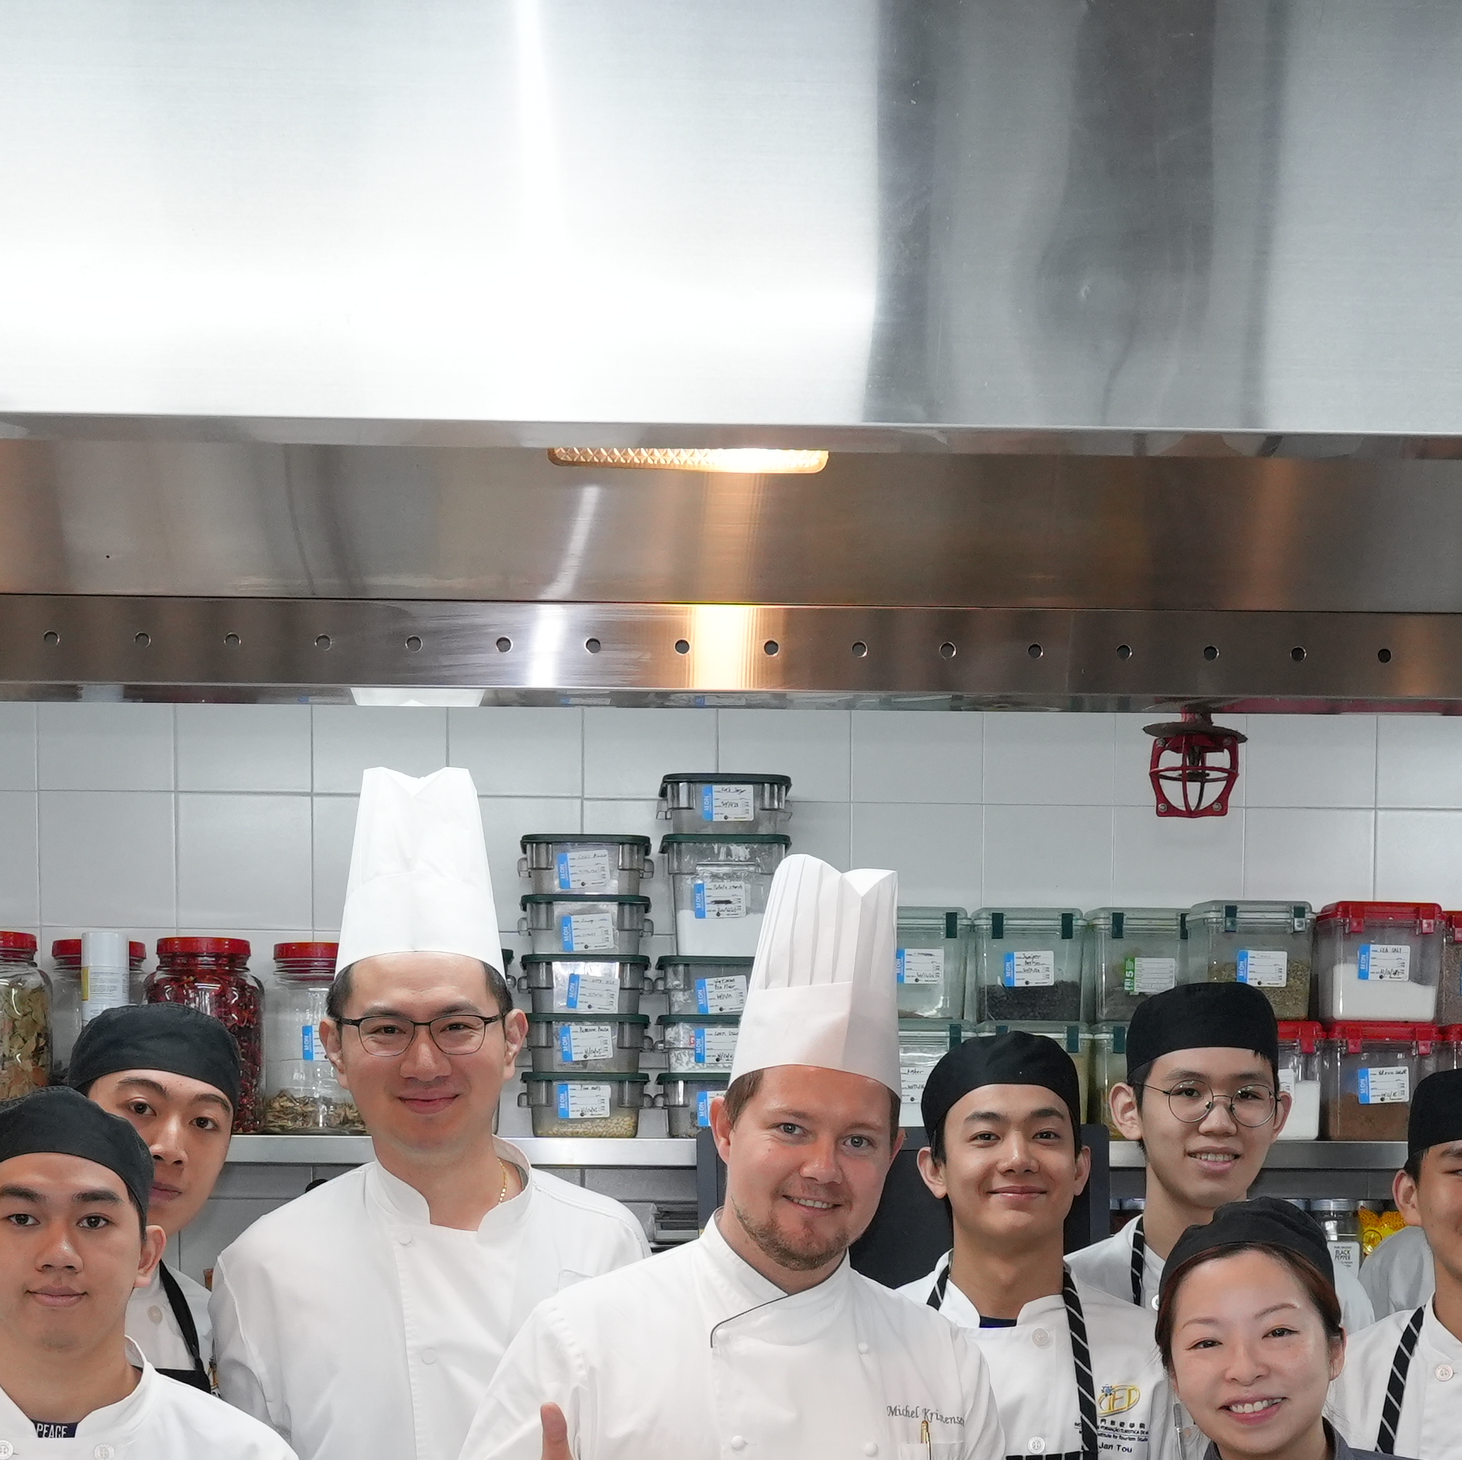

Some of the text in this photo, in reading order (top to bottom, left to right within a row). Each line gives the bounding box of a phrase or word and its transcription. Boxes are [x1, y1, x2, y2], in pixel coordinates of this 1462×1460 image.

[1125, 970, 1134, 978] 5
[886, 1405, 920, 1418] Michel
[1099, 1442, 1132, 1453] Jan Tou
